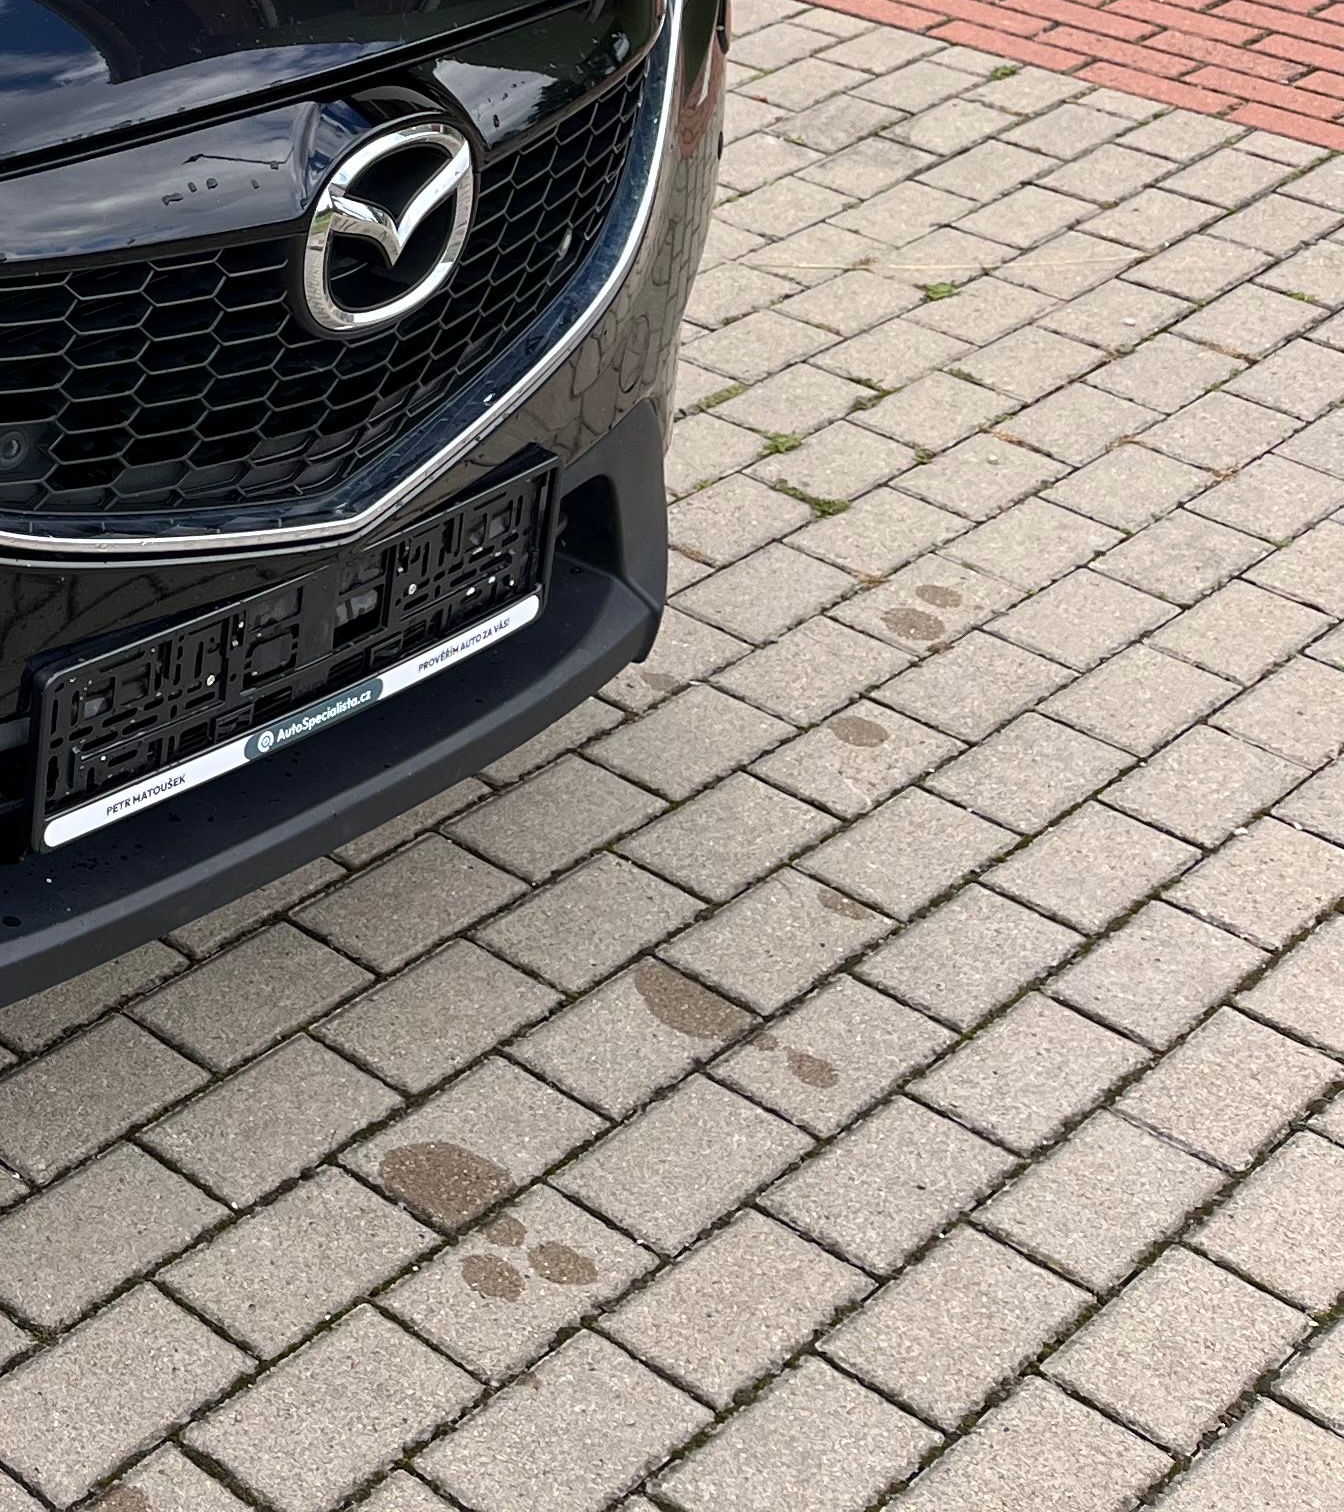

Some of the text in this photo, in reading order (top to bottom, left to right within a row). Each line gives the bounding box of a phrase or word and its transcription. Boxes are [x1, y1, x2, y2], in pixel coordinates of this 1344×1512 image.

[460, 633, 482, 651] AUTO
[482, 628, 493, 640] ZA
[276, 690, 372, 743] AutoSpecialista.cz
[106, 774, 186, 816] PETR MATOUŠEK
